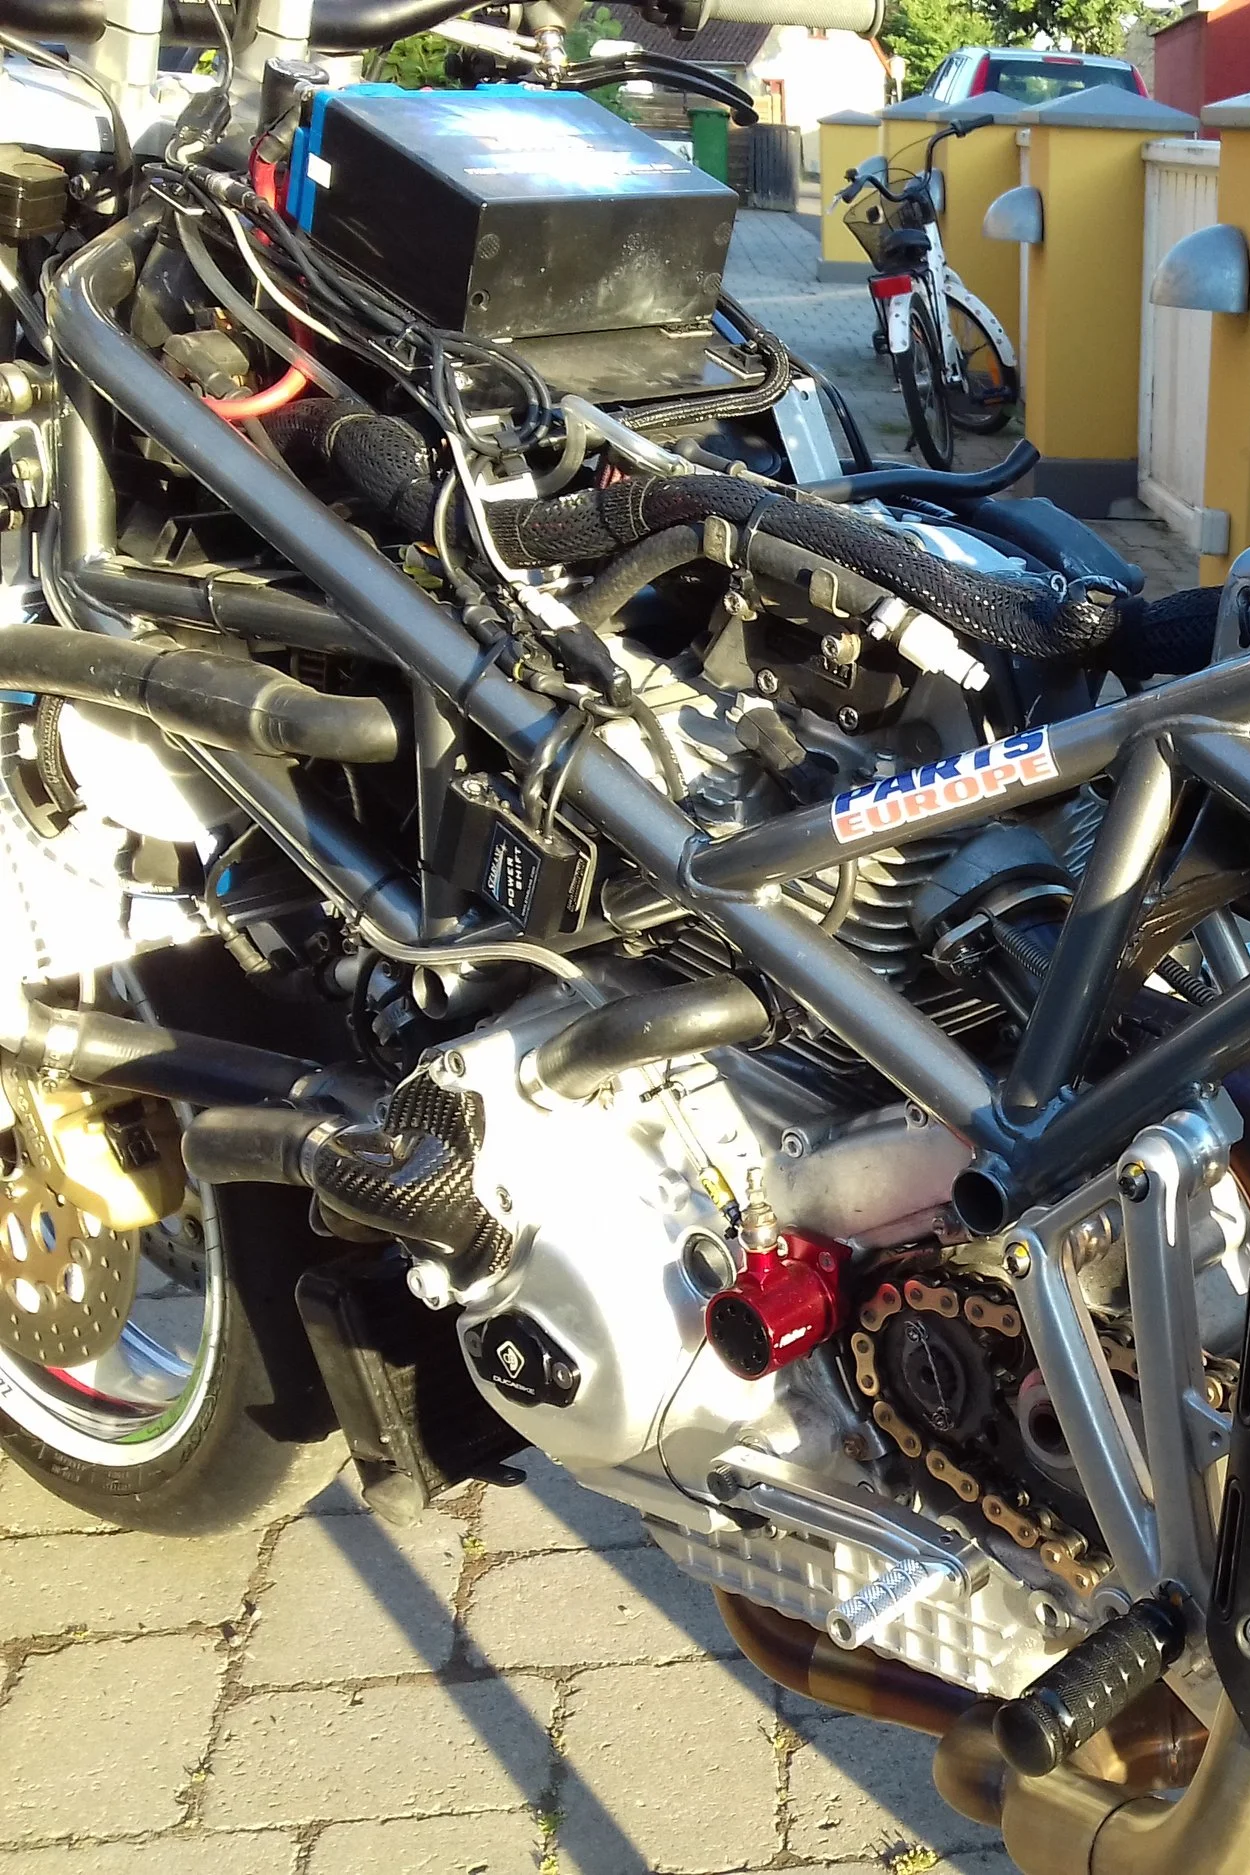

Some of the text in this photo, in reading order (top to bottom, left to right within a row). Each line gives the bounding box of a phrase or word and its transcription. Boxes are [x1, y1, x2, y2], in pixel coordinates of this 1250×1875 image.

[835, 725, 1044, 815] PARTS
[836, 753, 1052, 839] EUROPE
[506, 856, 515, 908] POWER
[514, 846, 523, 891] SHIFT
[493, 1374, 536, 1396] DUCABIKE
